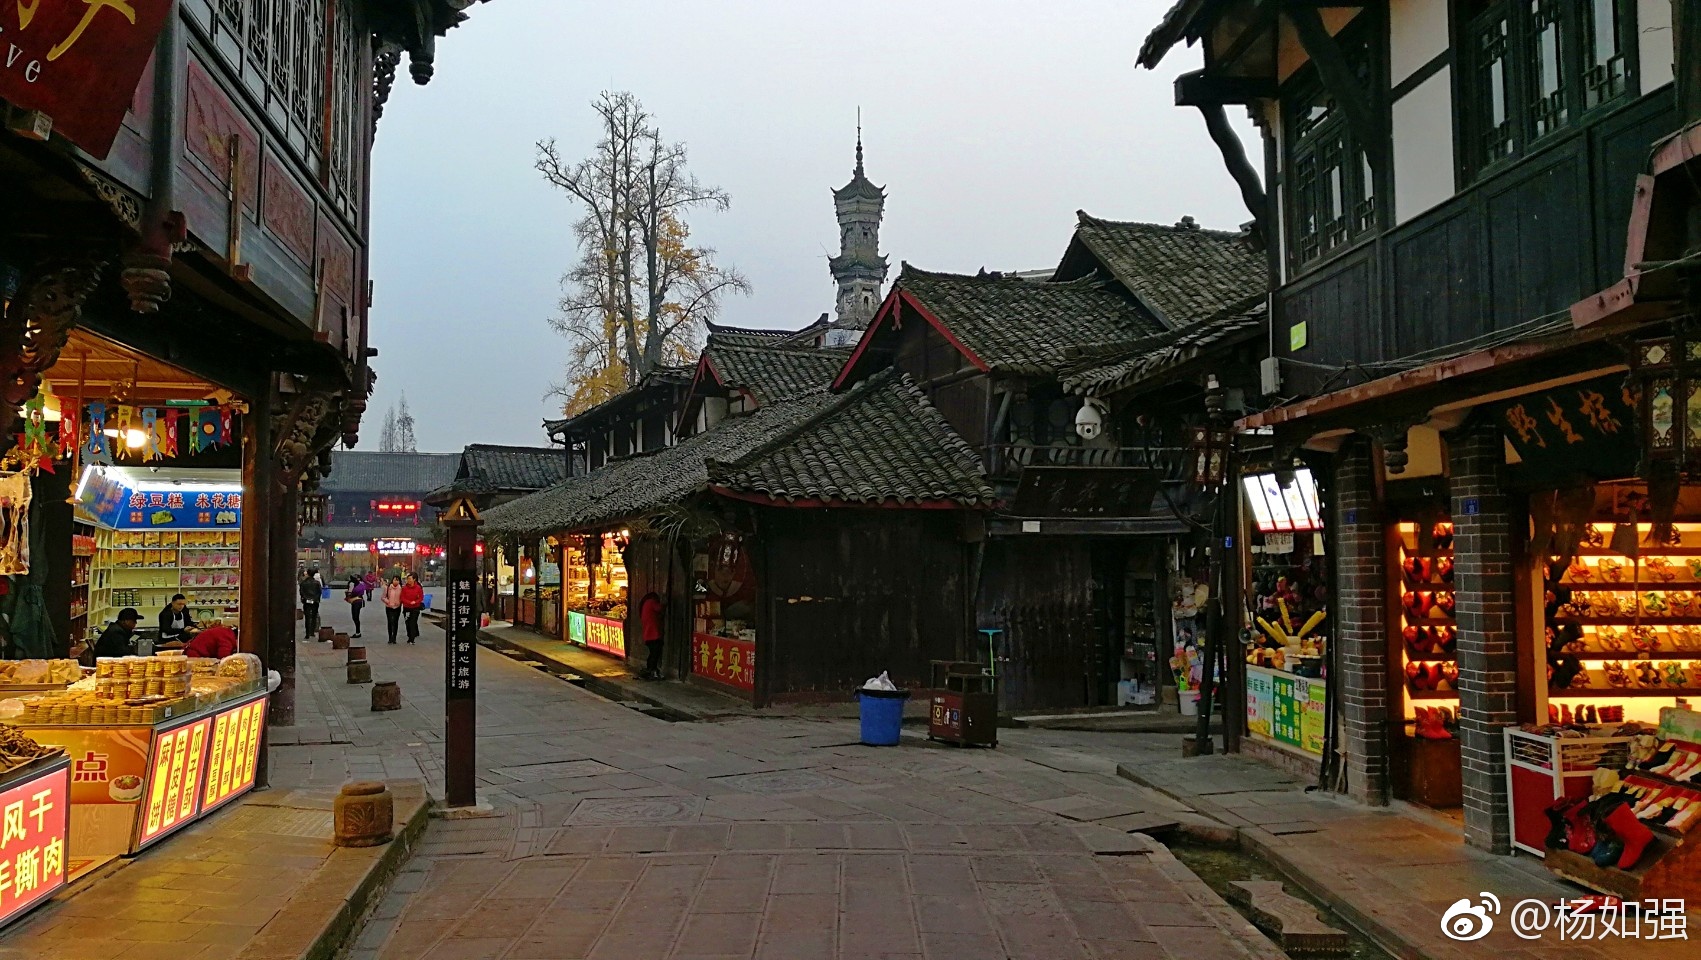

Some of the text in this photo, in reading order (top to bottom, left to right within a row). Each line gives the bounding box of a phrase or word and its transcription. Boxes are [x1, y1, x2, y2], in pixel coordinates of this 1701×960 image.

[129, 493, 184, 508] 绿豆糕
[195, 493, 241, 508] 米花糖
[458, 580, 470, 689] 魅力街子 舒心旅游
[73, 751, 109, 783] 点
[0, 788, 54, 851] 风干
